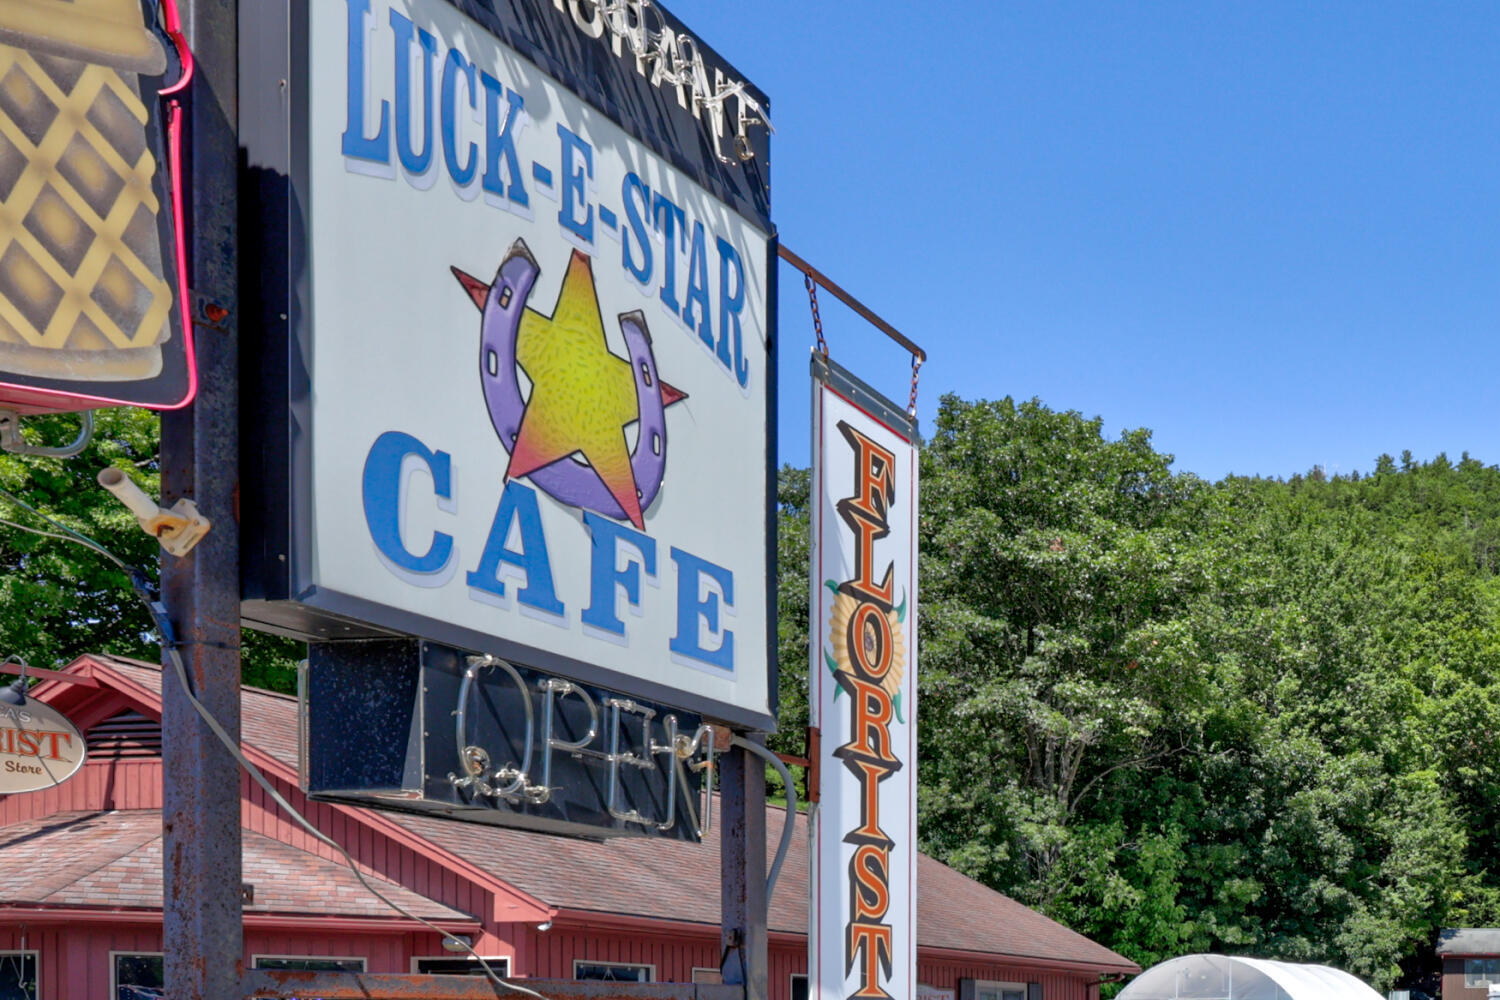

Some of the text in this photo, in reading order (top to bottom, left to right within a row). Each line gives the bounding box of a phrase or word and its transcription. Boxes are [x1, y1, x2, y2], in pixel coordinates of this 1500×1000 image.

[342, 0, 749, 389] LUCK-E-STAR
[362, 430, 735, 673] CAFE
[0, 728, 72, 763] IST
[5, 760, 43, 775] Store
